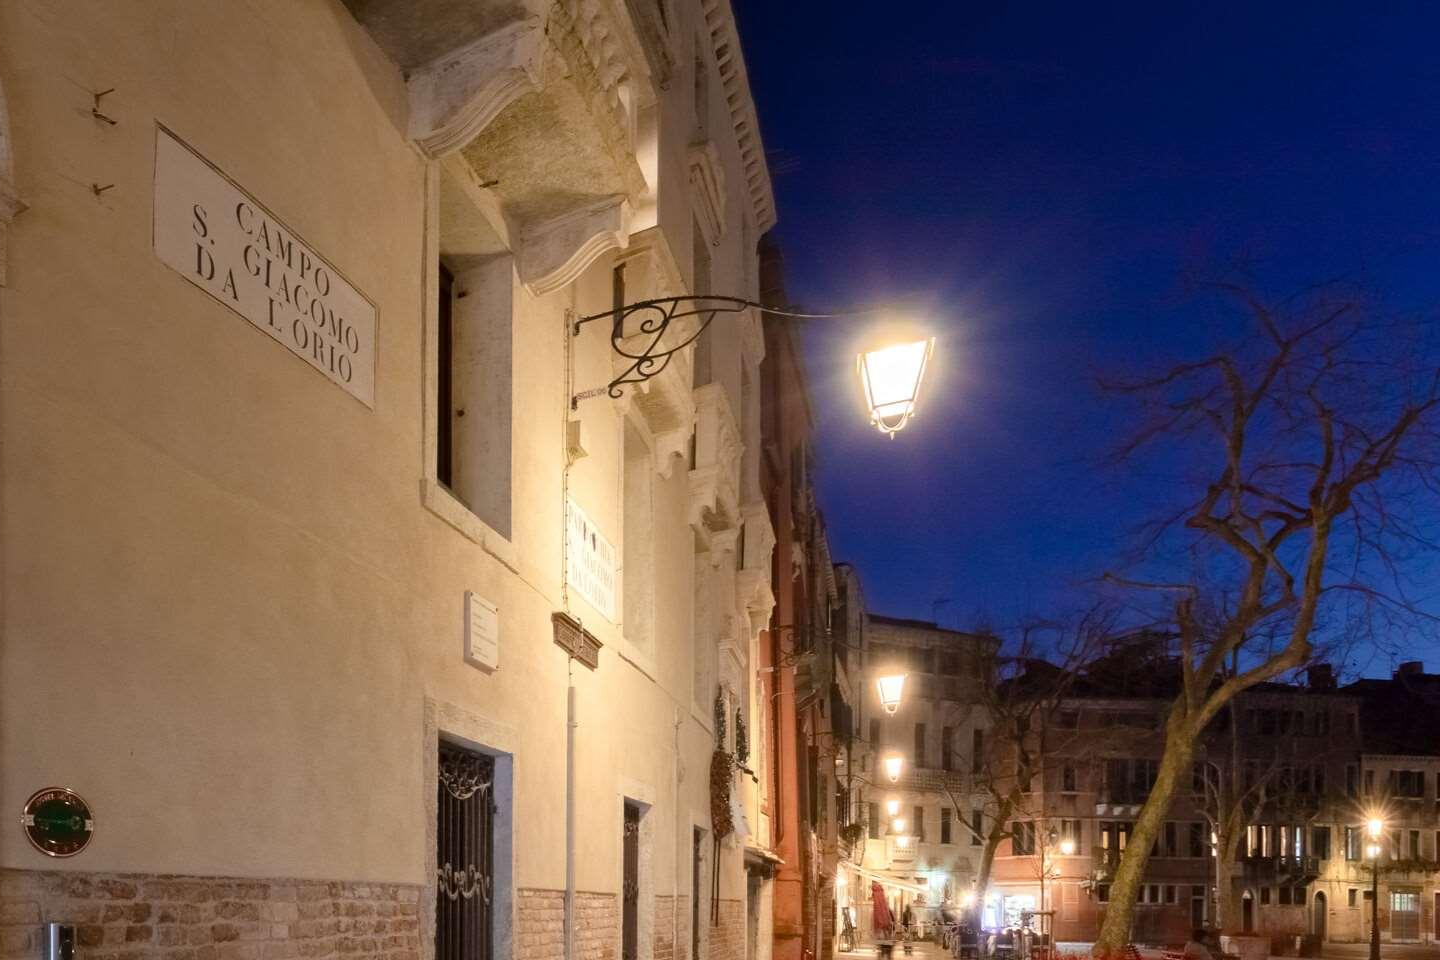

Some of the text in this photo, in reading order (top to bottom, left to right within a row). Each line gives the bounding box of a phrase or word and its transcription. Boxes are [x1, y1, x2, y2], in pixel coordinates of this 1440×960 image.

[193, 204, 358, 354] S. GIACOMO
[196, 243, 239, 301] DA
[236, 202, 330, 297] CAMPO
